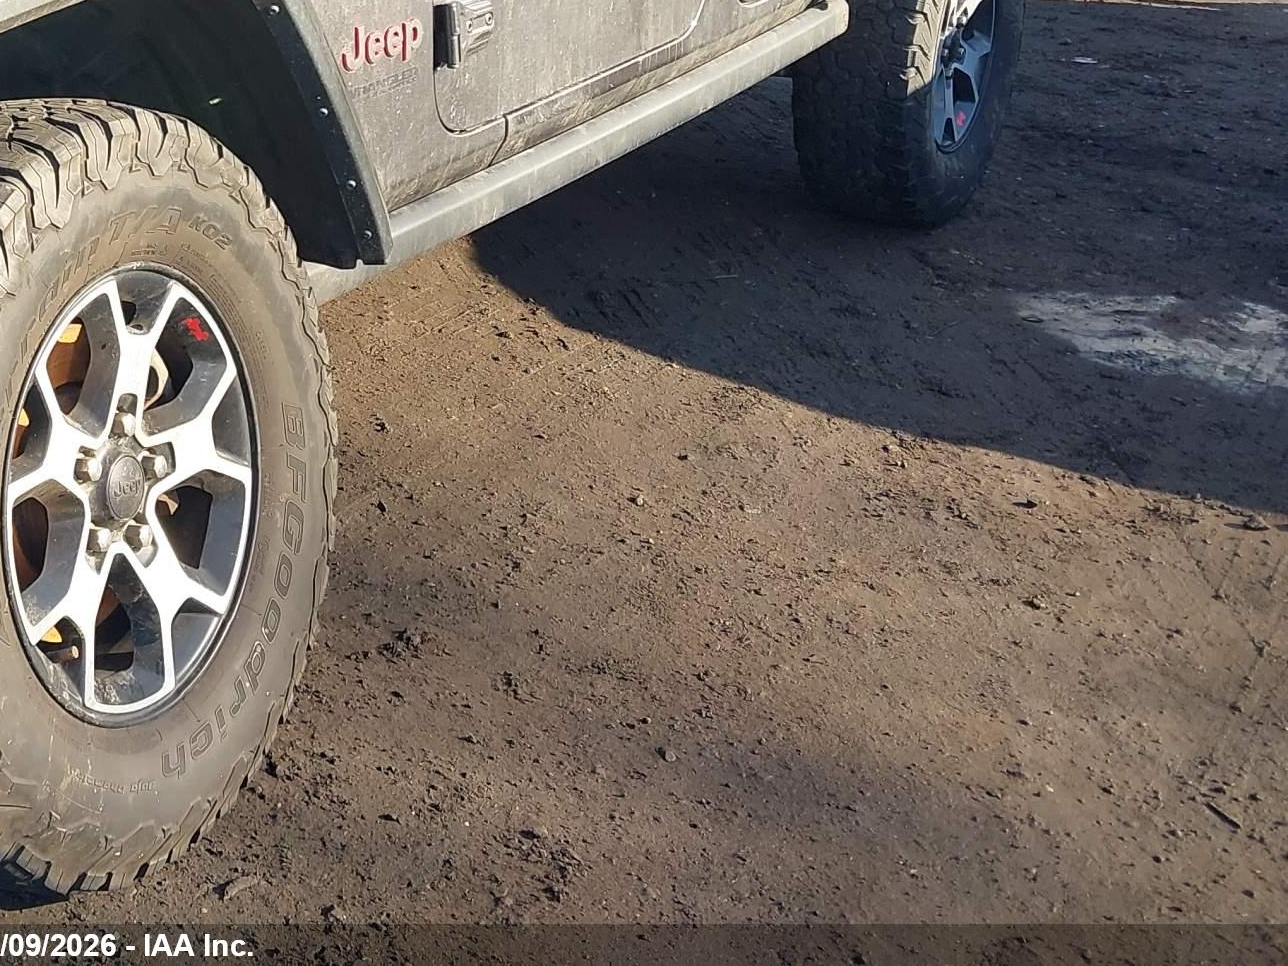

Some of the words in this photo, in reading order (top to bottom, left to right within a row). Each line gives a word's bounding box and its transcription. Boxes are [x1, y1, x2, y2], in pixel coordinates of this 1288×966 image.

[340, 17, 423, 73] Jeep
[187, 216, 233, 251] KO2
[113, 478, 142, 499] Jeep
[161, 401, 307, 779] BFGoodrich
